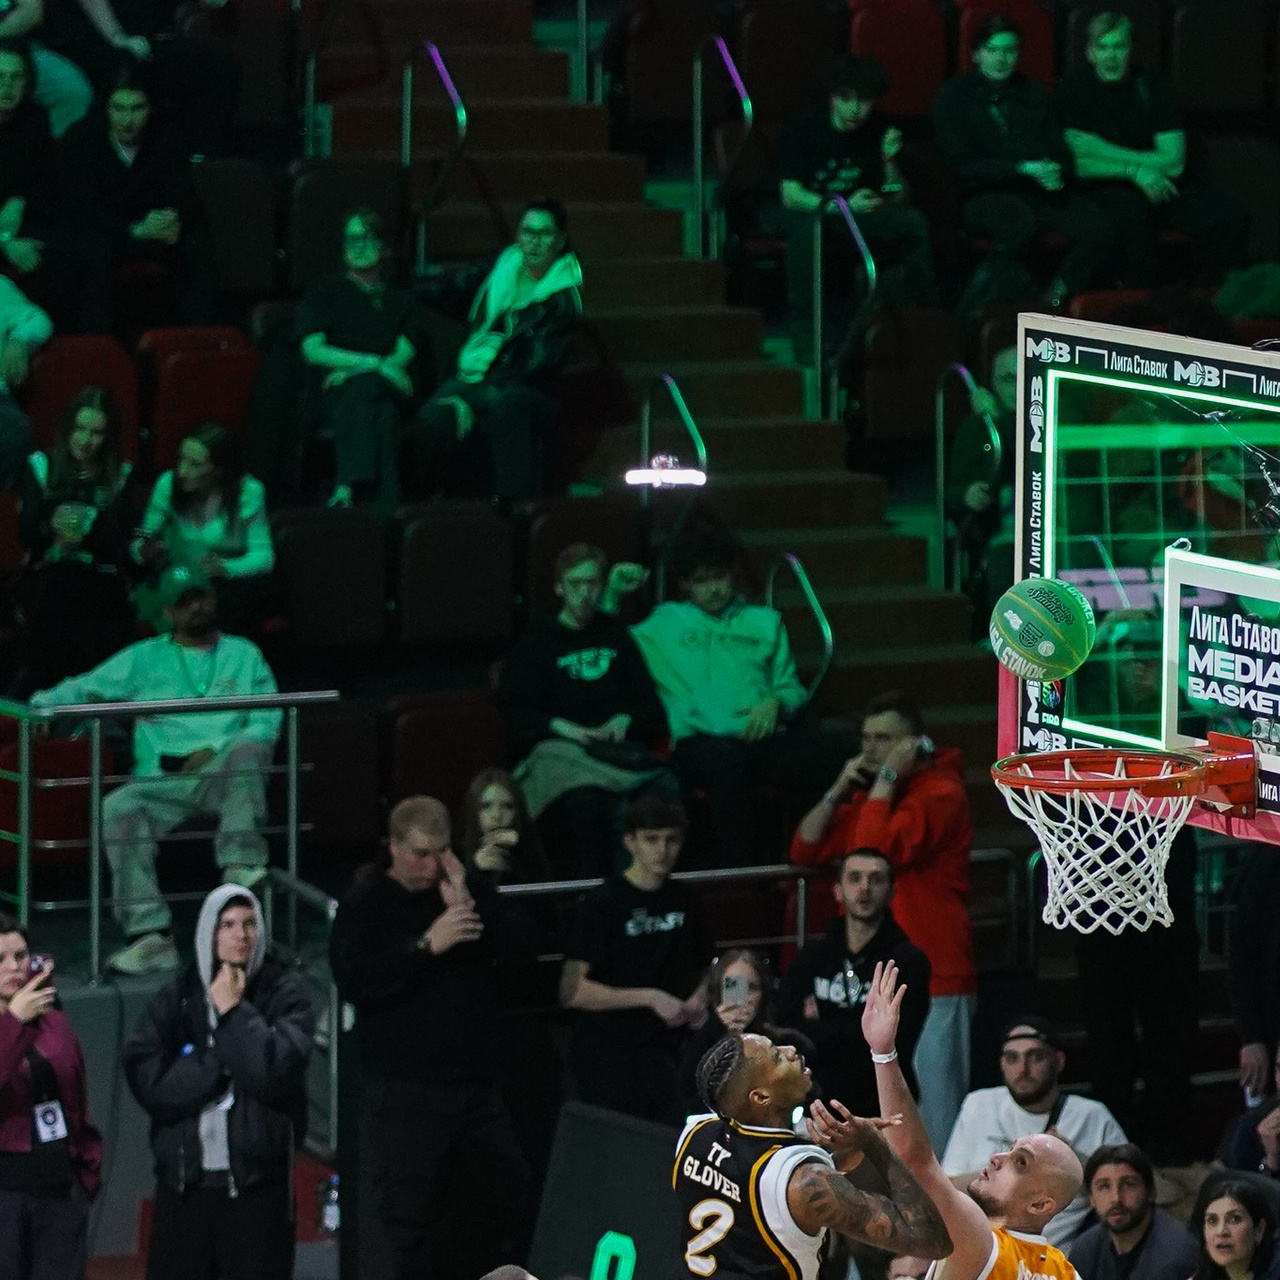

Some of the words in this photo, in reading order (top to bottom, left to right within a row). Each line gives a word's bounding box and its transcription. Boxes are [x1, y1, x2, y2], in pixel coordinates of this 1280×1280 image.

[1001, 646, 1047, 679] STAVOK
[707, 1141, 732, 1167] TY
[683, 1155, 742, 1203] GLOVER
[684, 1198, 735, 1277] 2
